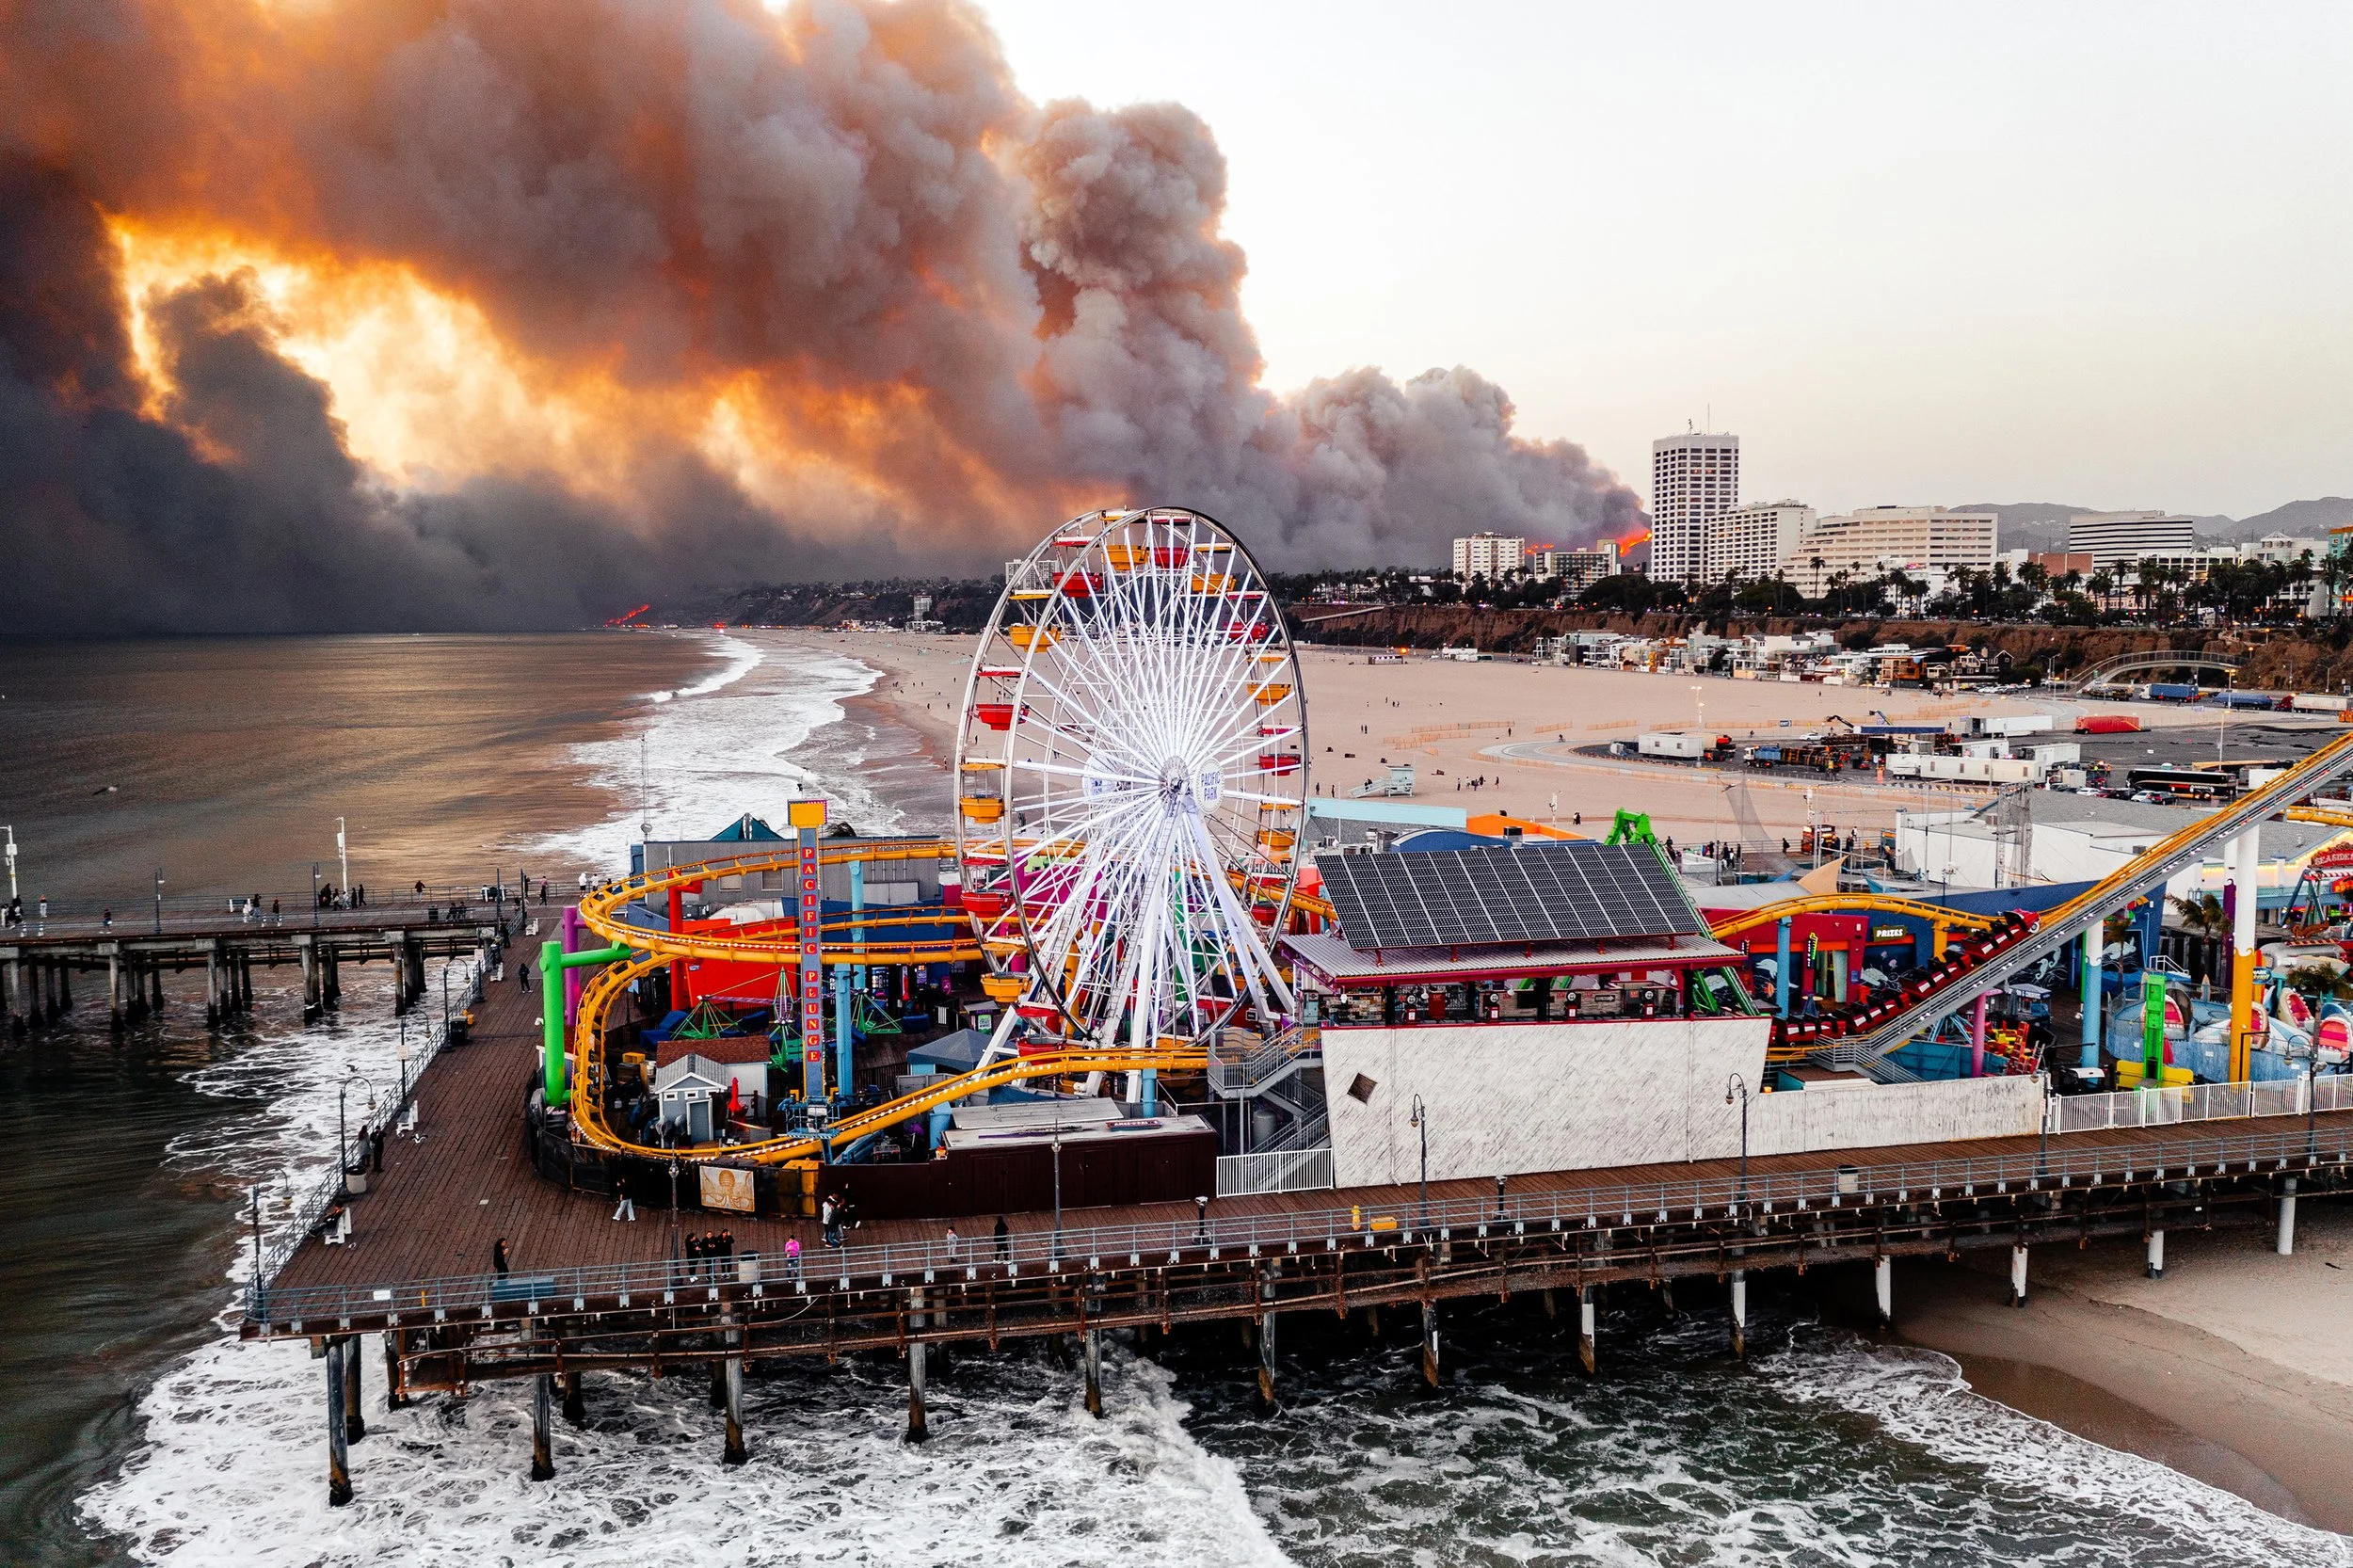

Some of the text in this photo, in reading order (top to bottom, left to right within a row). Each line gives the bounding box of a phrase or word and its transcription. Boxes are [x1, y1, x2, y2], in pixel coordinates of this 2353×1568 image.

[1200, 771, 1221, 788] PACIFIC
[1204, 787, 1218, 801] PARK
[1876, 928, 1903, 937] PRIZES
[804, 848, 819, 1063] PACIFIC PLUNGE
